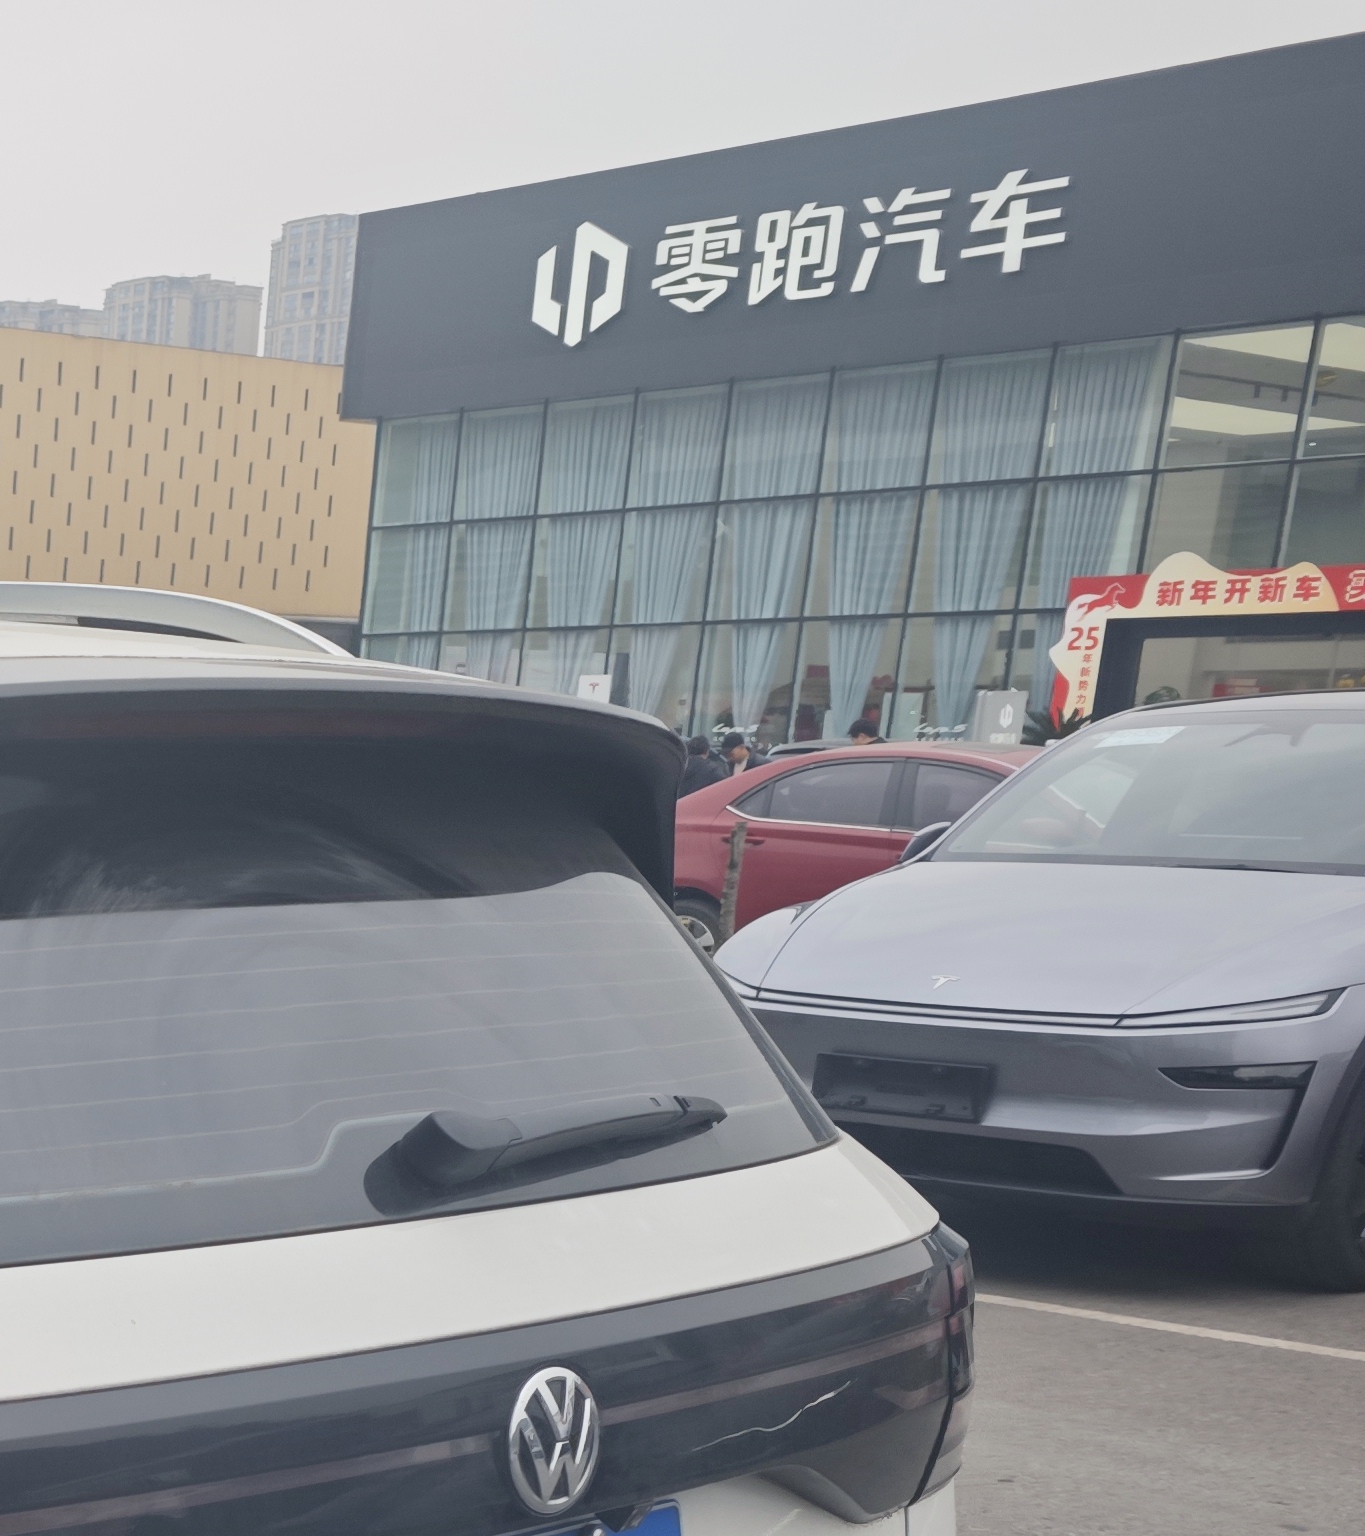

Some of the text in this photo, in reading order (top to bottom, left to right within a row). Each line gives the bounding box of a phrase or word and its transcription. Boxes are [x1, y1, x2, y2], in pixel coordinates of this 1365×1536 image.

[651, 168, 1071, 314] 零跑汽车
[1156, 574, 1322, 607] 新年开新车
[1067, 626, 1100, 651] 25
